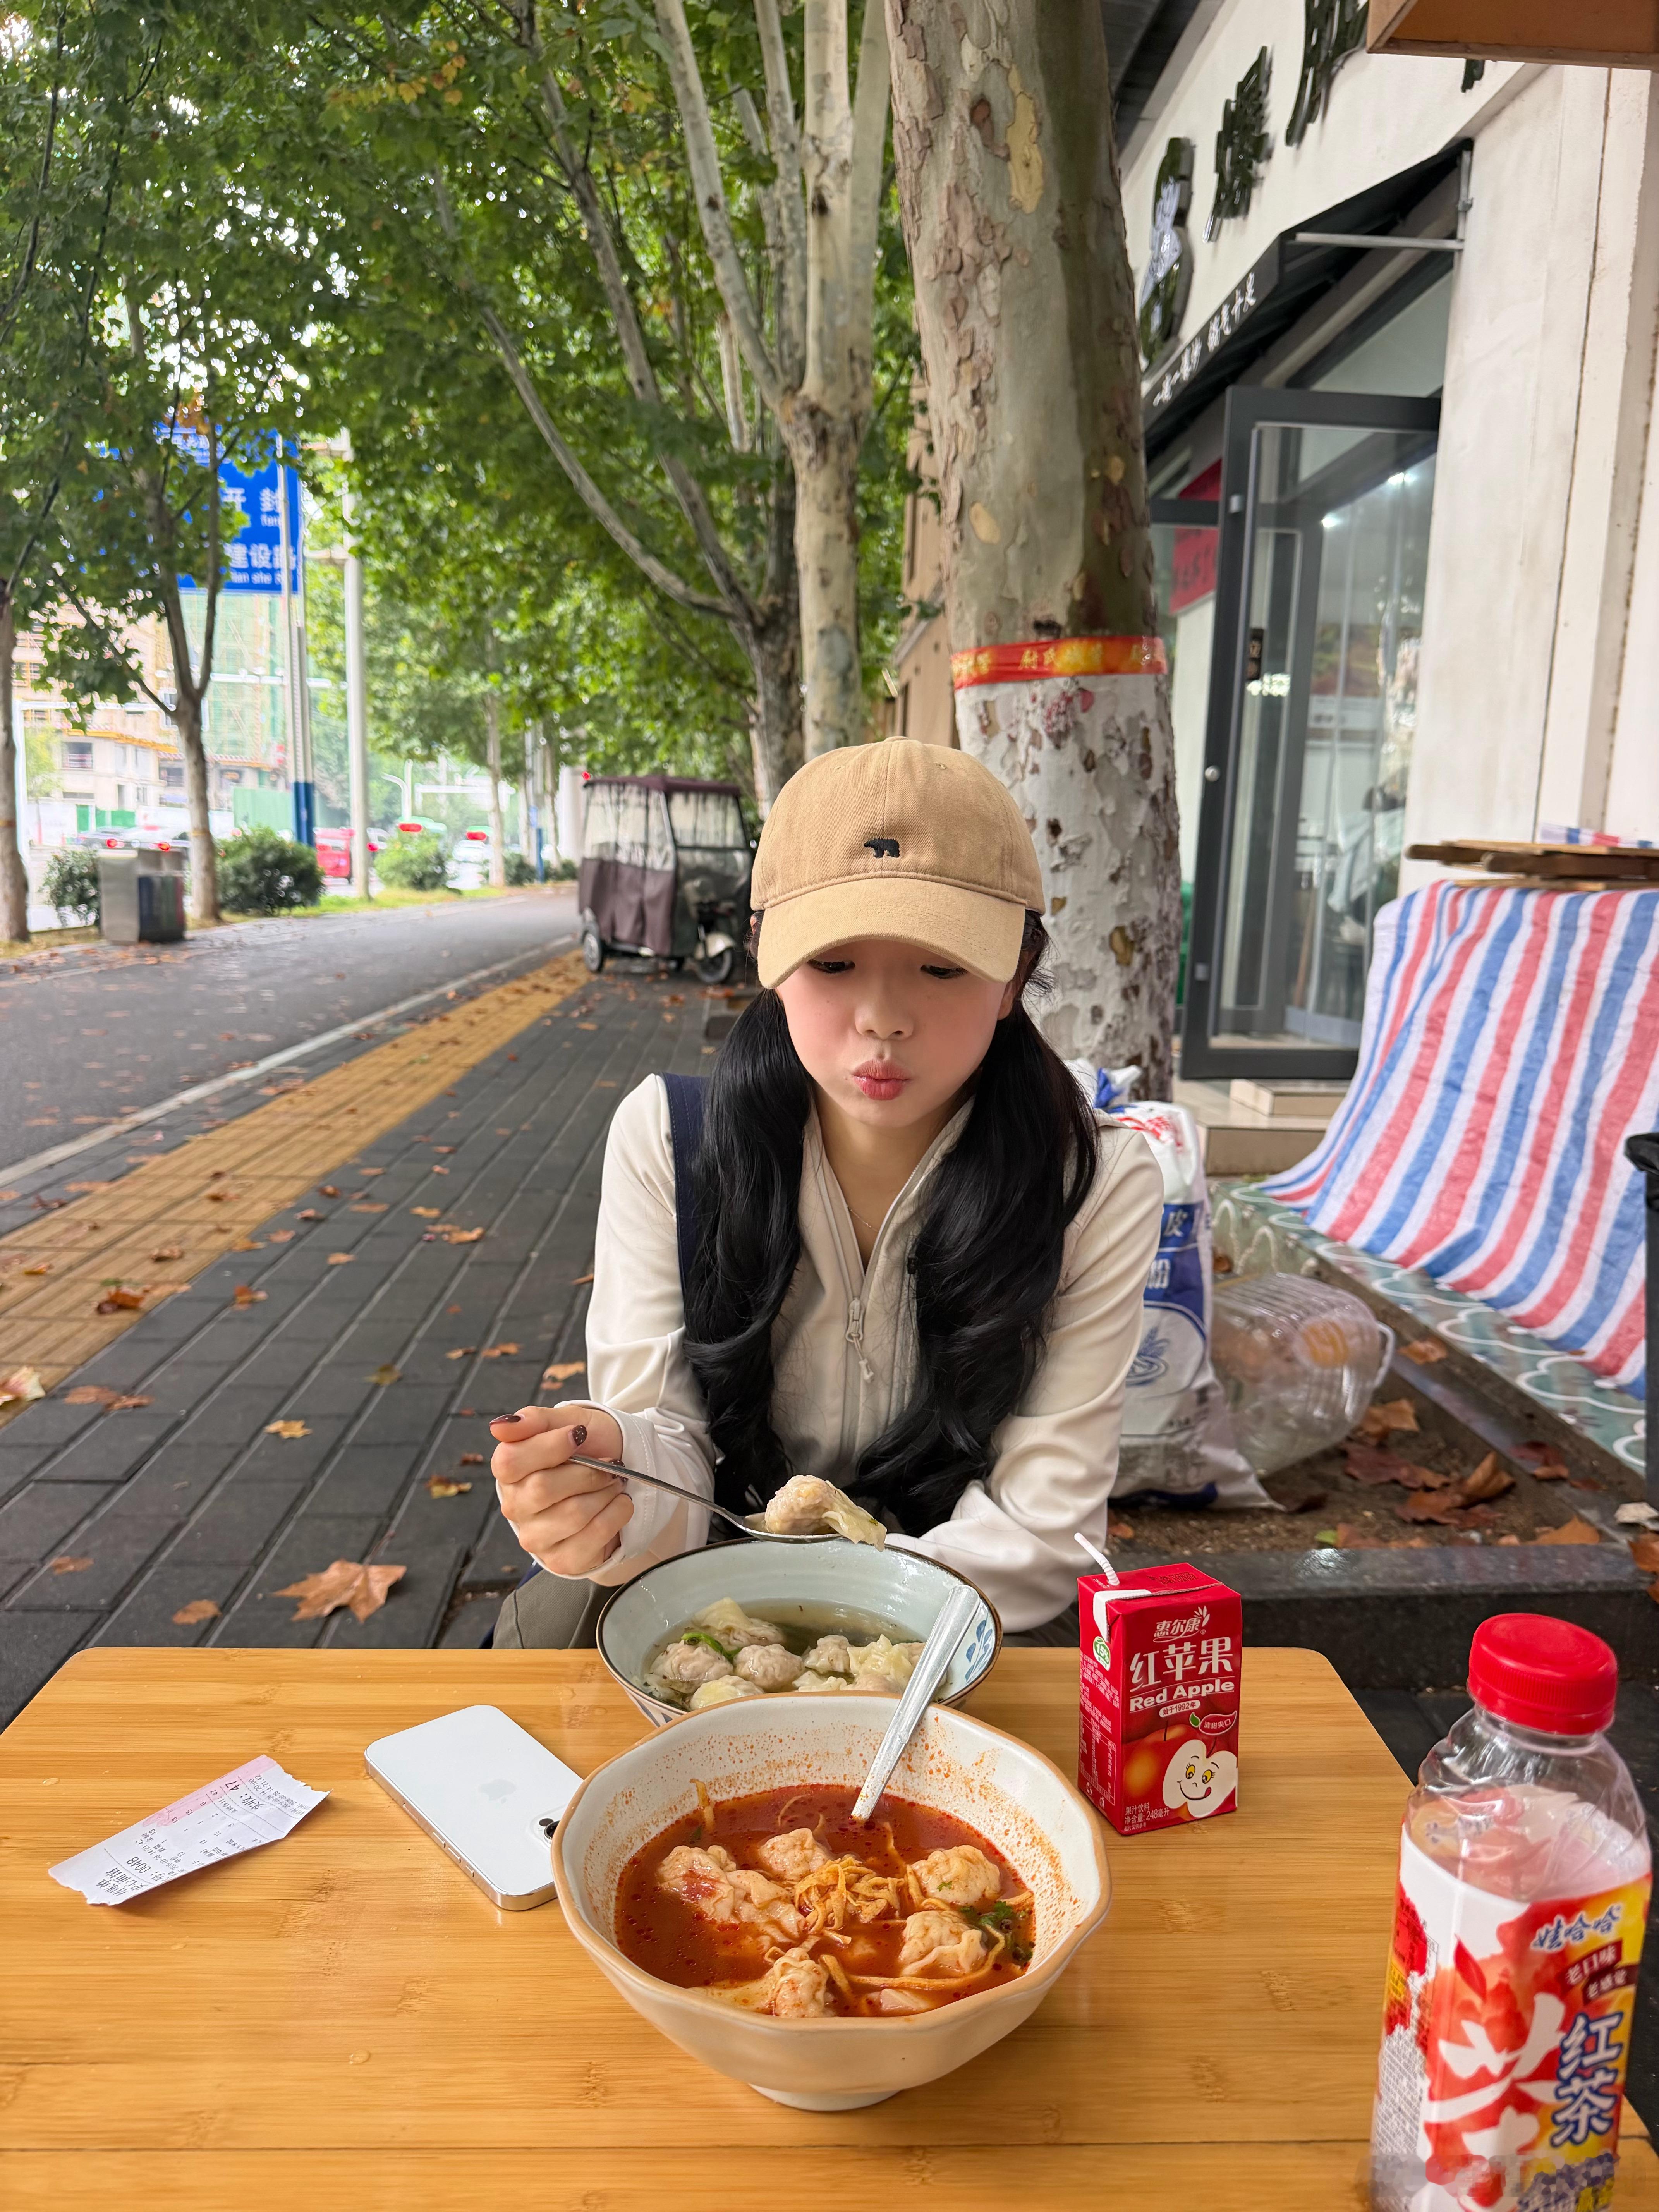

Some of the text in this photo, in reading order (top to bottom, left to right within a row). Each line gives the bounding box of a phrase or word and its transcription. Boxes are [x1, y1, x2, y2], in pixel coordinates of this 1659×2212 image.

[1154, 1617, 1202, 1637] 惠尔康
[1096, 1644, 1109, 1663] 15%
[1130, 1637, 1233, 1692] 红苹果
[1130, 1688, 1167, 1711] Red
[1172, 1679, 1235, 1699] Apple
[1163, 1701, 1196, 1715] 始于1992年
[1204, 1719, 1231, 1729] 清甜爽口
[248, 1778, 267, 1796] 14:20:00
[255, 1775, 274, 1792] 14:21:42
[225, 1781, 266, 1810] 实收: 47
[1125, 1802, 1149, 1815] 果汁饮料
[136, 1839, 156, 1855] 14:21:42
[126, 1856, 151, 1874] 0048
[1532, 1905, 1621, 1950] 娃哈哈
[1566, 1944, 1617, 1985] 老口味
[1550, 2011, 1623, 2147] 红茶
